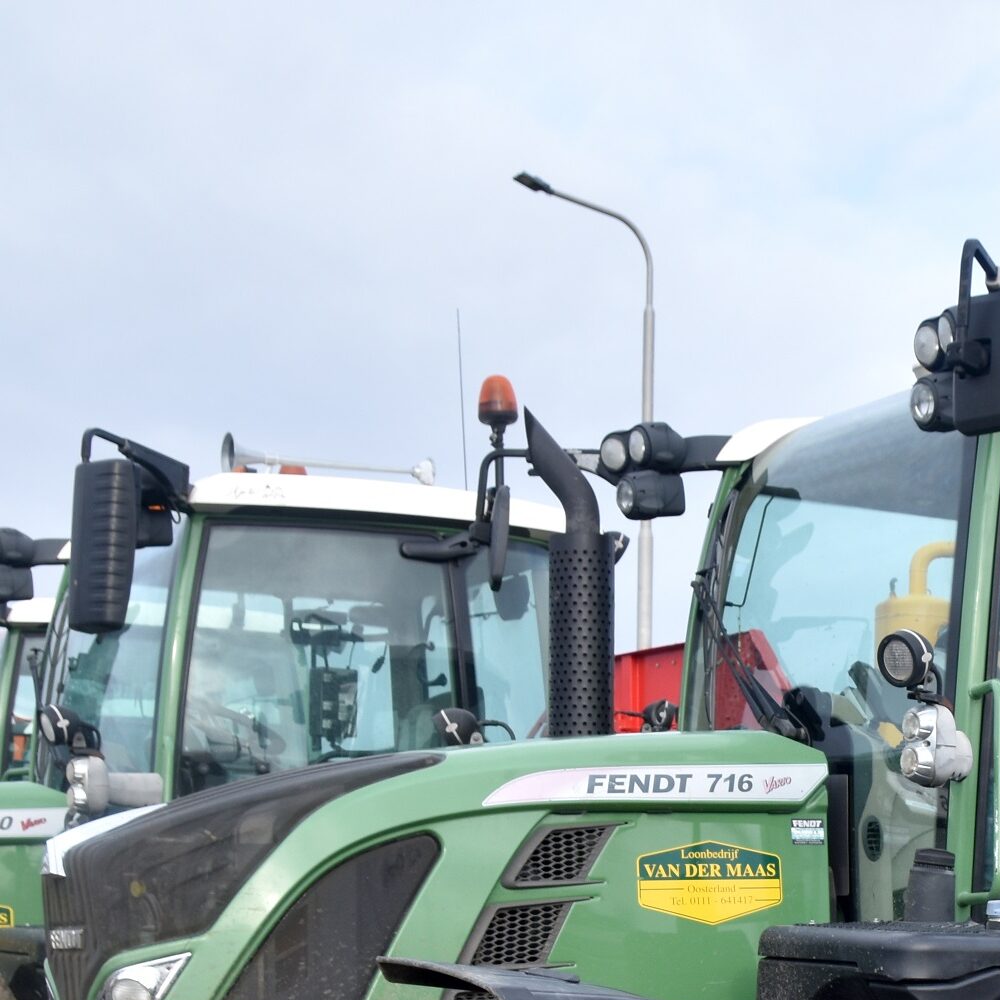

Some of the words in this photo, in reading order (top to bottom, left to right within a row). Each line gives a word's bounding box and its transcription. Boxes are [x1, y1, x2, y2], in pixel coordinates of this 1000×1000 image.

[586, 773, 693, 794] FENDT
[706, 773, 753, 793] 716
[791, 819, 822, 828] FENDT
[681, 848, 740, 860] Loonbedrijf
[643, 863, 681, 878] VAN
[684, 863, 722, 878] DER
[726, 863, 776, 878] MAAS
[687, 884, 737, 894] Oosterland
